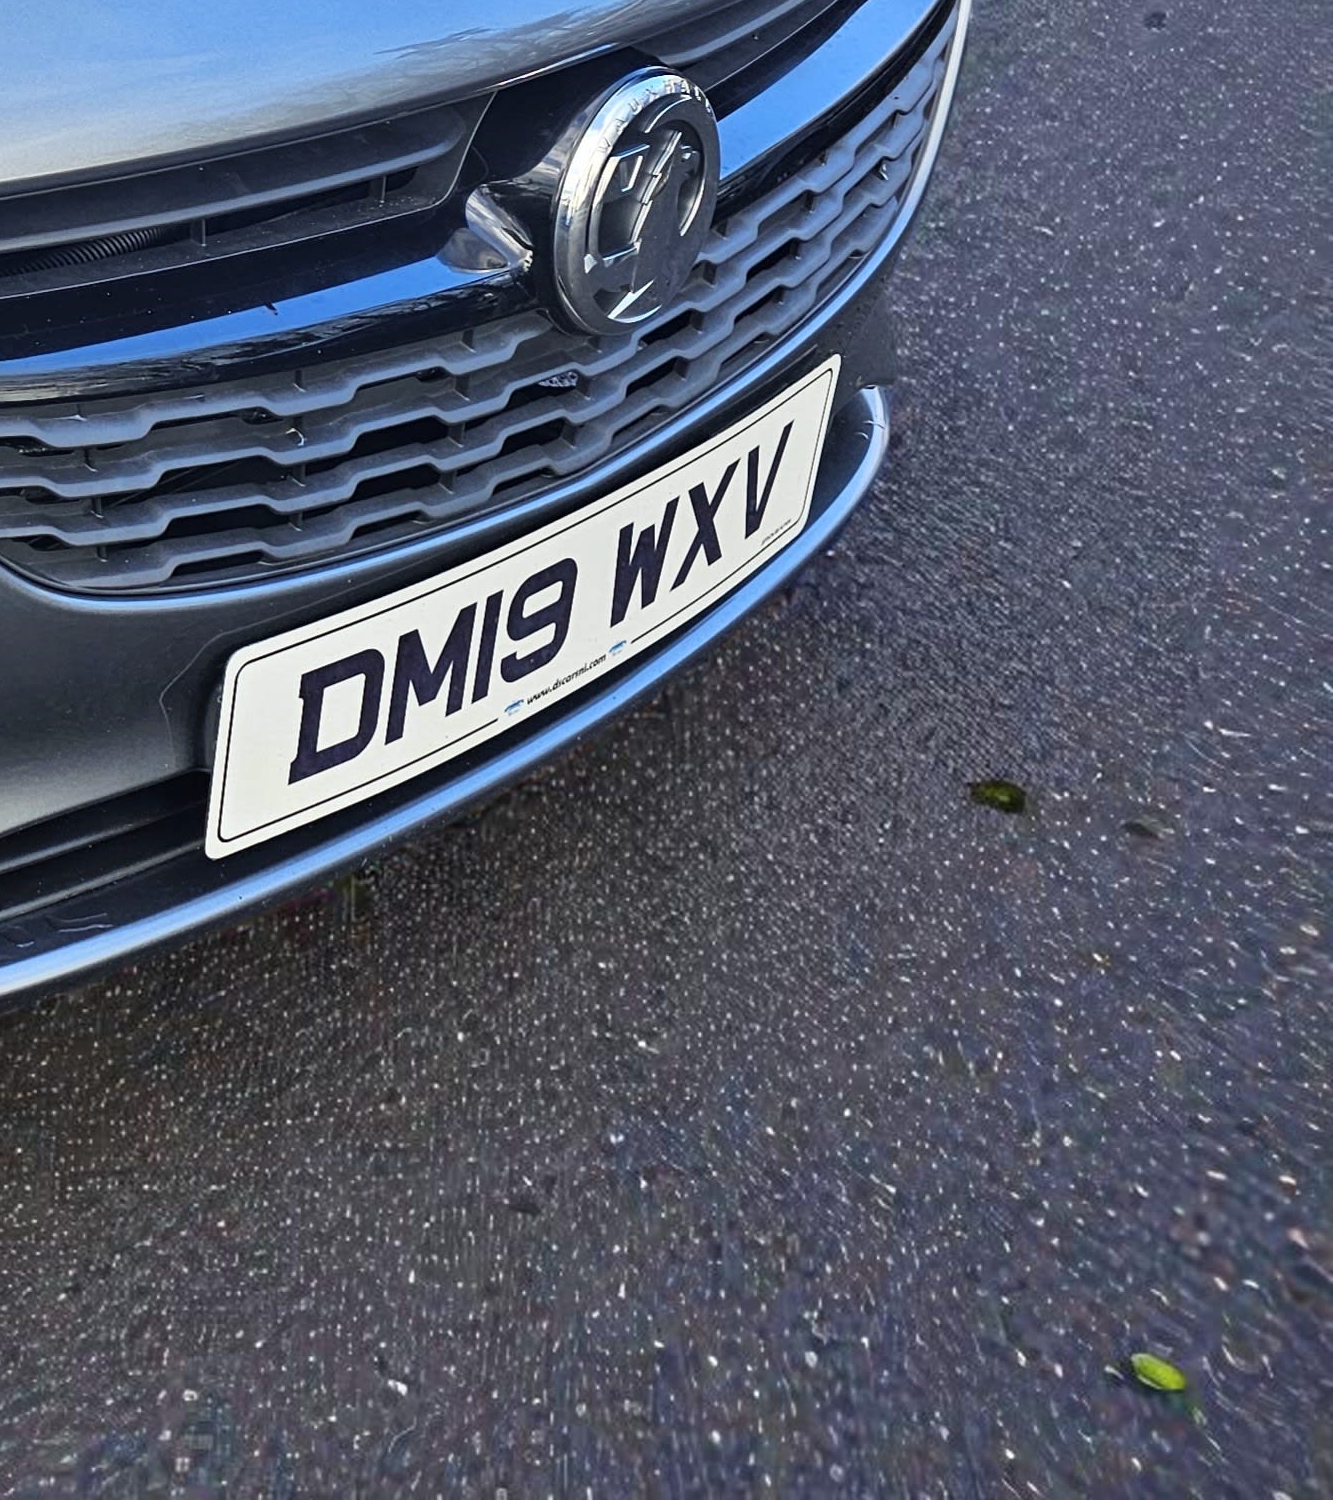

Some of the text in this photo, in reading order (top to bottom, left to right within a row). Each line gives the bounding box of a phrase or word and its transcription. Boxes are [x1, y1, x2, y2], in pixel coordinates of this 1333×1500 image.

[288, 420, 794, 785] DM19 WXV
[526, 653, 607, 706] www.dscarsni.com
